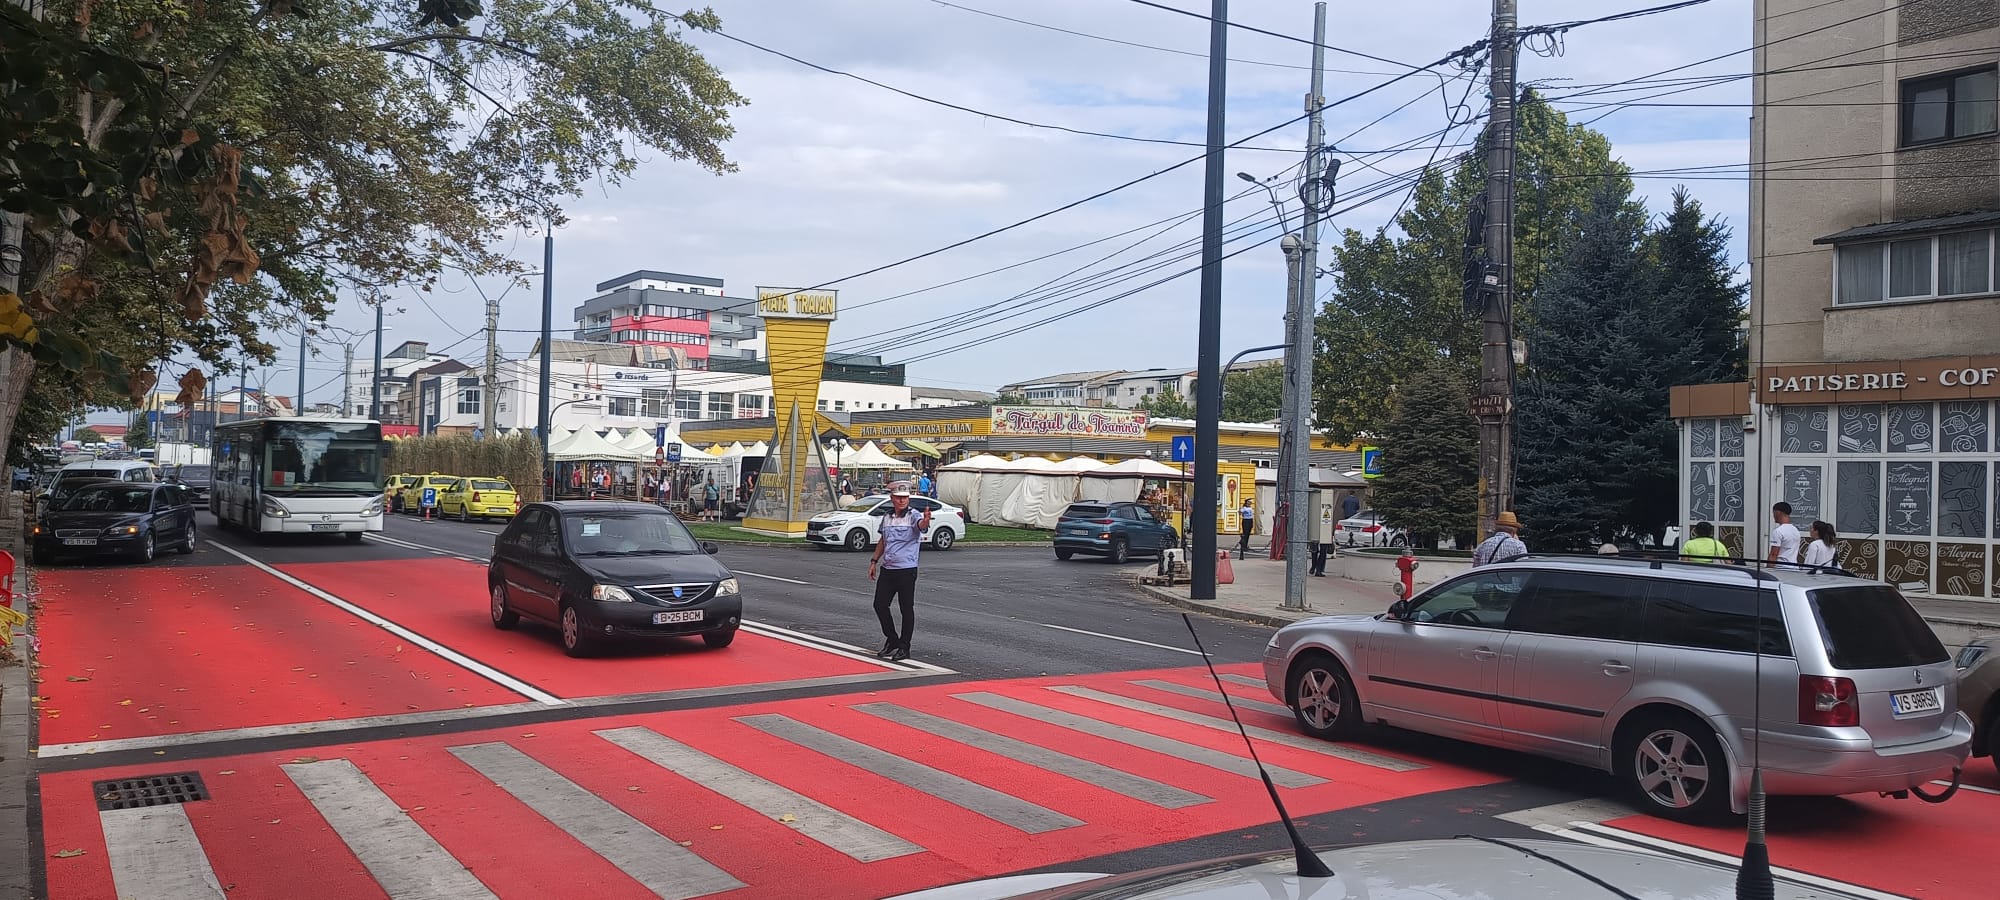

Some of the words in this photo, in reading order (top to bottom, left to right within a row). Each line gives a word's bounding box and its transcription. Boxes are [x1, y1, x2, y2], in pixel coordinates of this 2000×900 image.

[795, 294, 833, 314] TRAIAN
[1769, 372, 1909, 392] PATISERIE
[1939, 367, 1999, 387] COF
[944, 423, 972, 433] TRAIAN
[1068, 411, 1085, 430] de
[1937, 545, 1985, 562] Alegria
[670, 613, 681, 621] 25
[683, 612, 701, 620] BCM
[1896, 695, 1912, 711] VS
